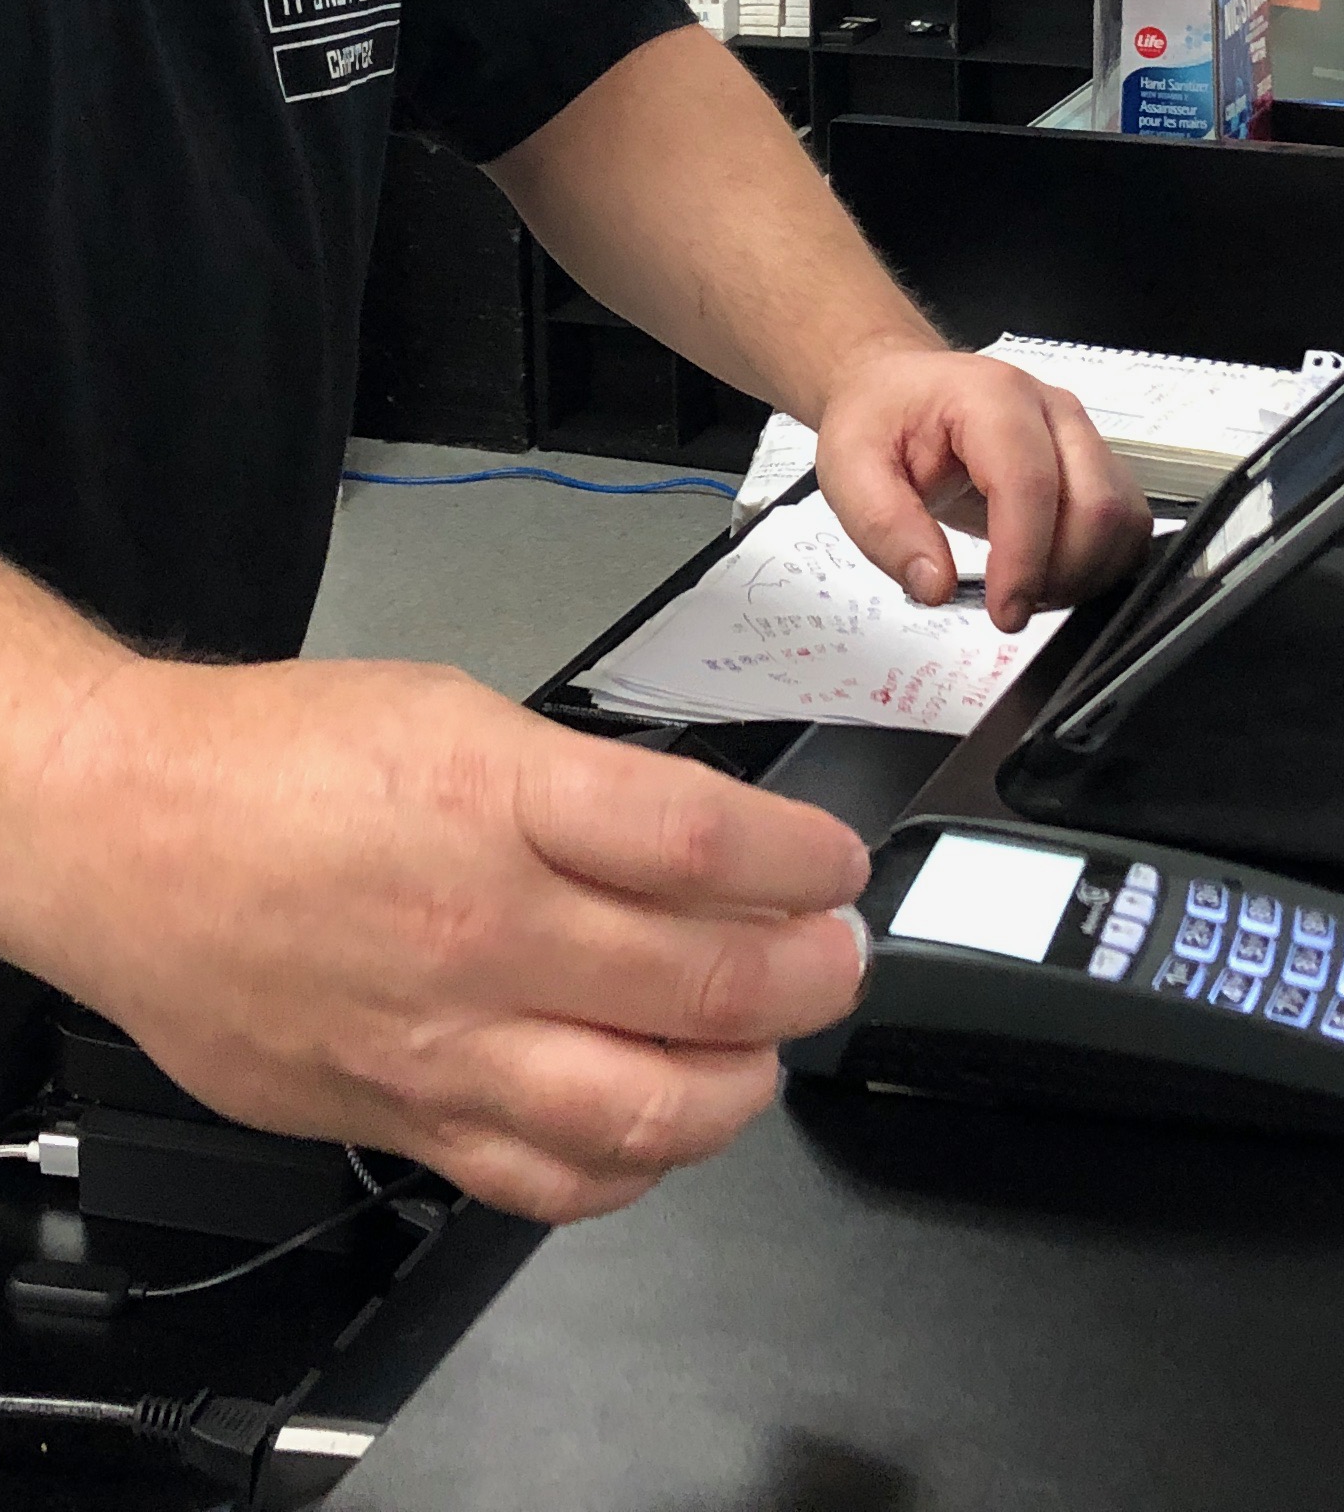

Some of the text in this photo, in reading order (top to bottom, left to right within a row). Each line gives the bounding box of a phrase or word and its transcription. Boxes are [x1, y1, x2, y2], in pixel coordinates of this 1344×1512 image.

[1136, 34, 1165, 50] Life
[326, 39, 374, 80] CHPTE
[1140, 76, 1209, 93] Hand Sanitizer
[1139, 100, 1198, 116] Assainisseur
[1138, 116, 1208, 129] pour les mains
